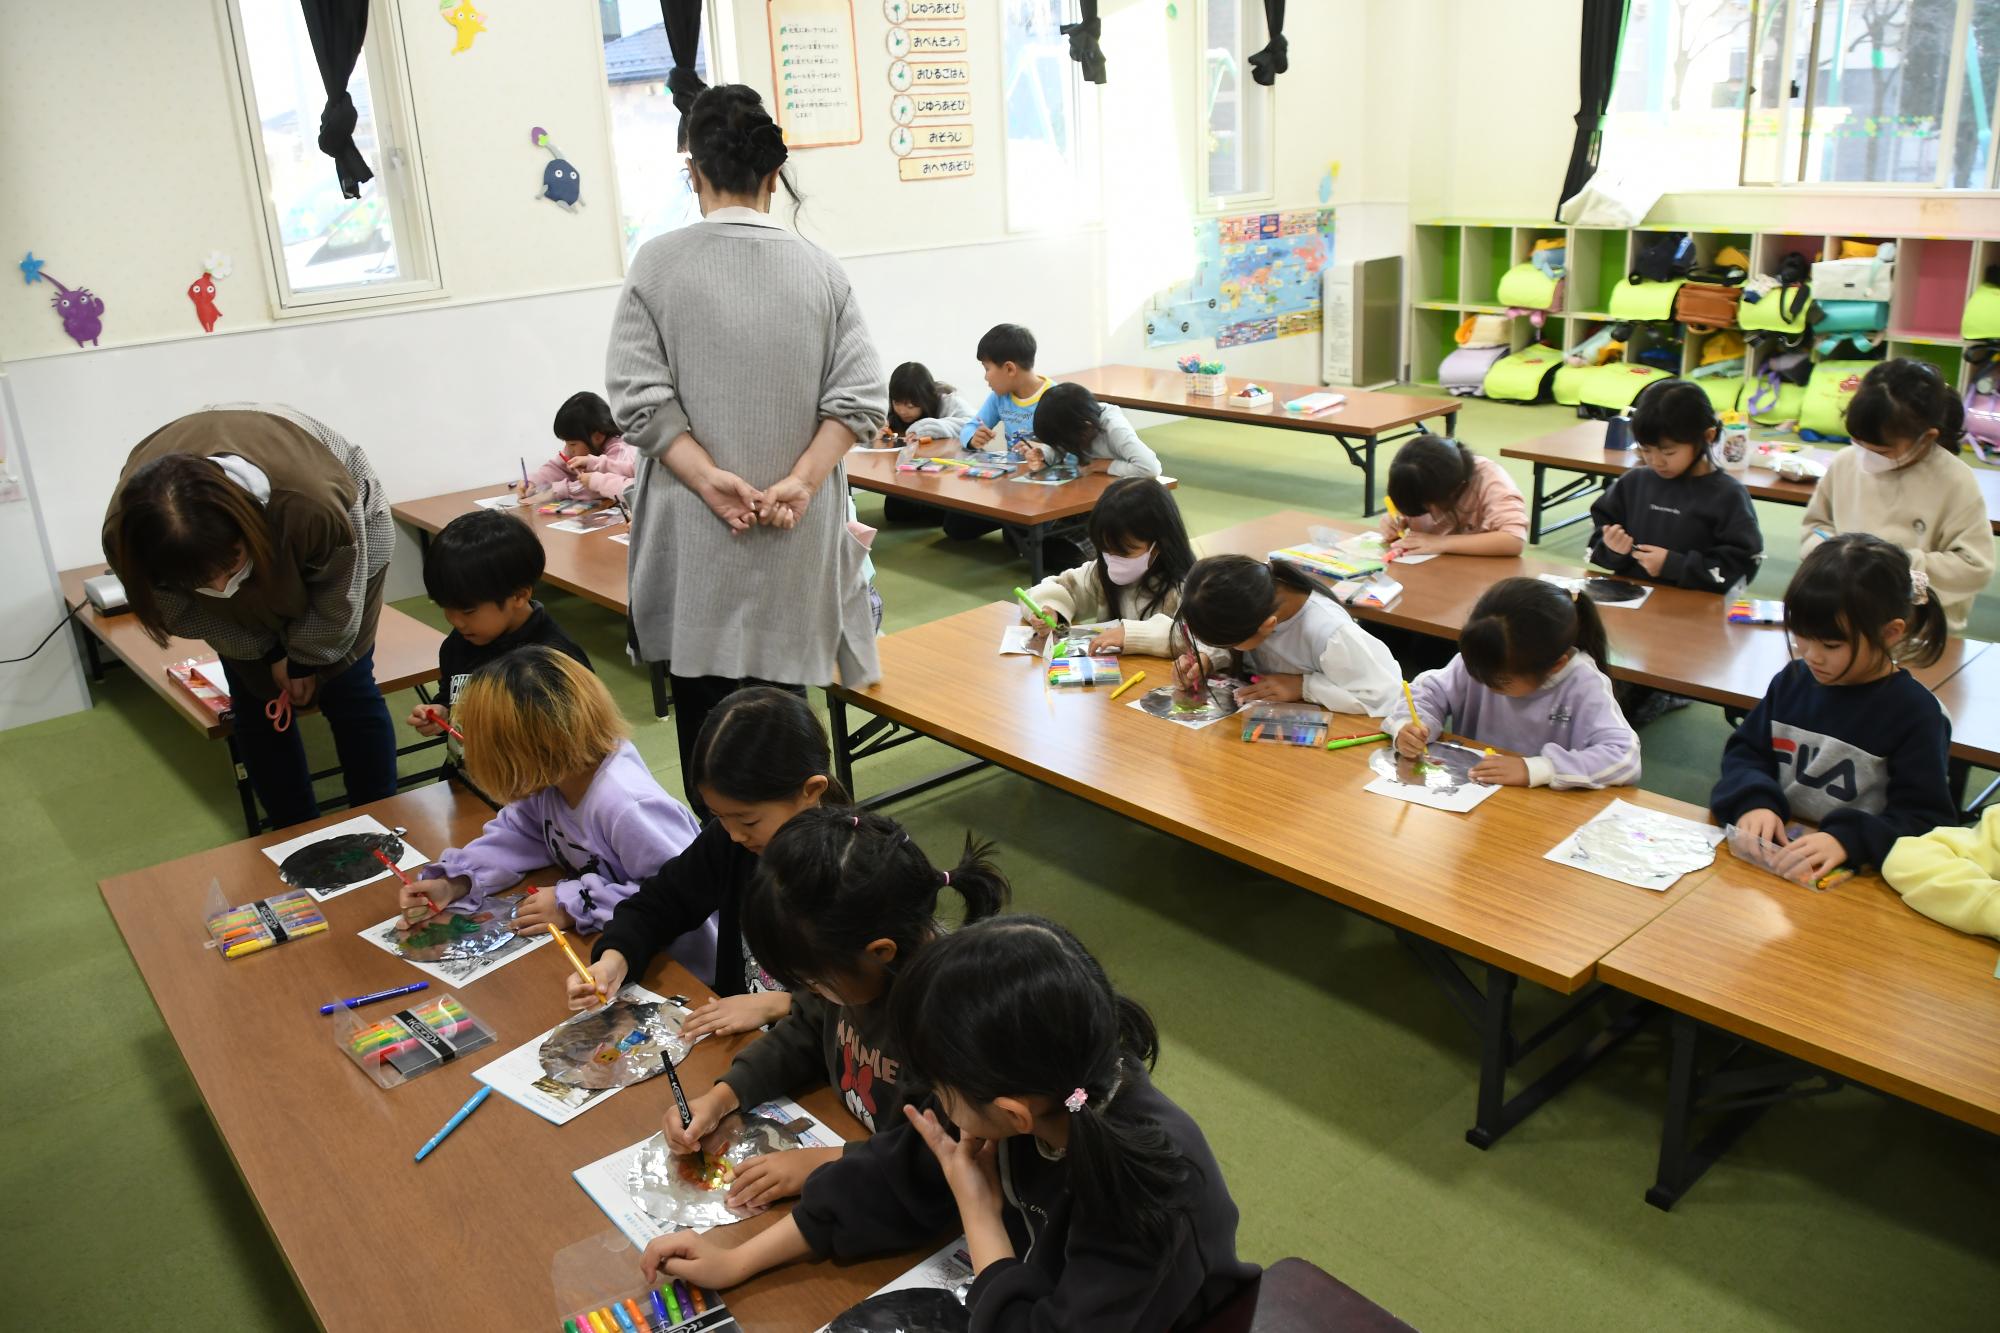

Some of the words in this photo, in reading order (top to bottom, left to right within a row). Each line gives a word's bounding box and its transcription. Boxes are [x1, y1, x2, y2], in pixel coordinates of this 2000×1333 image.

[913, 35, 960, 48] おべんきょう
[916, 68, 966, 80] おひるごはん
[929, 131, 962, 143] おそうじ
[923, 160, 974, 174] おへやあそび
